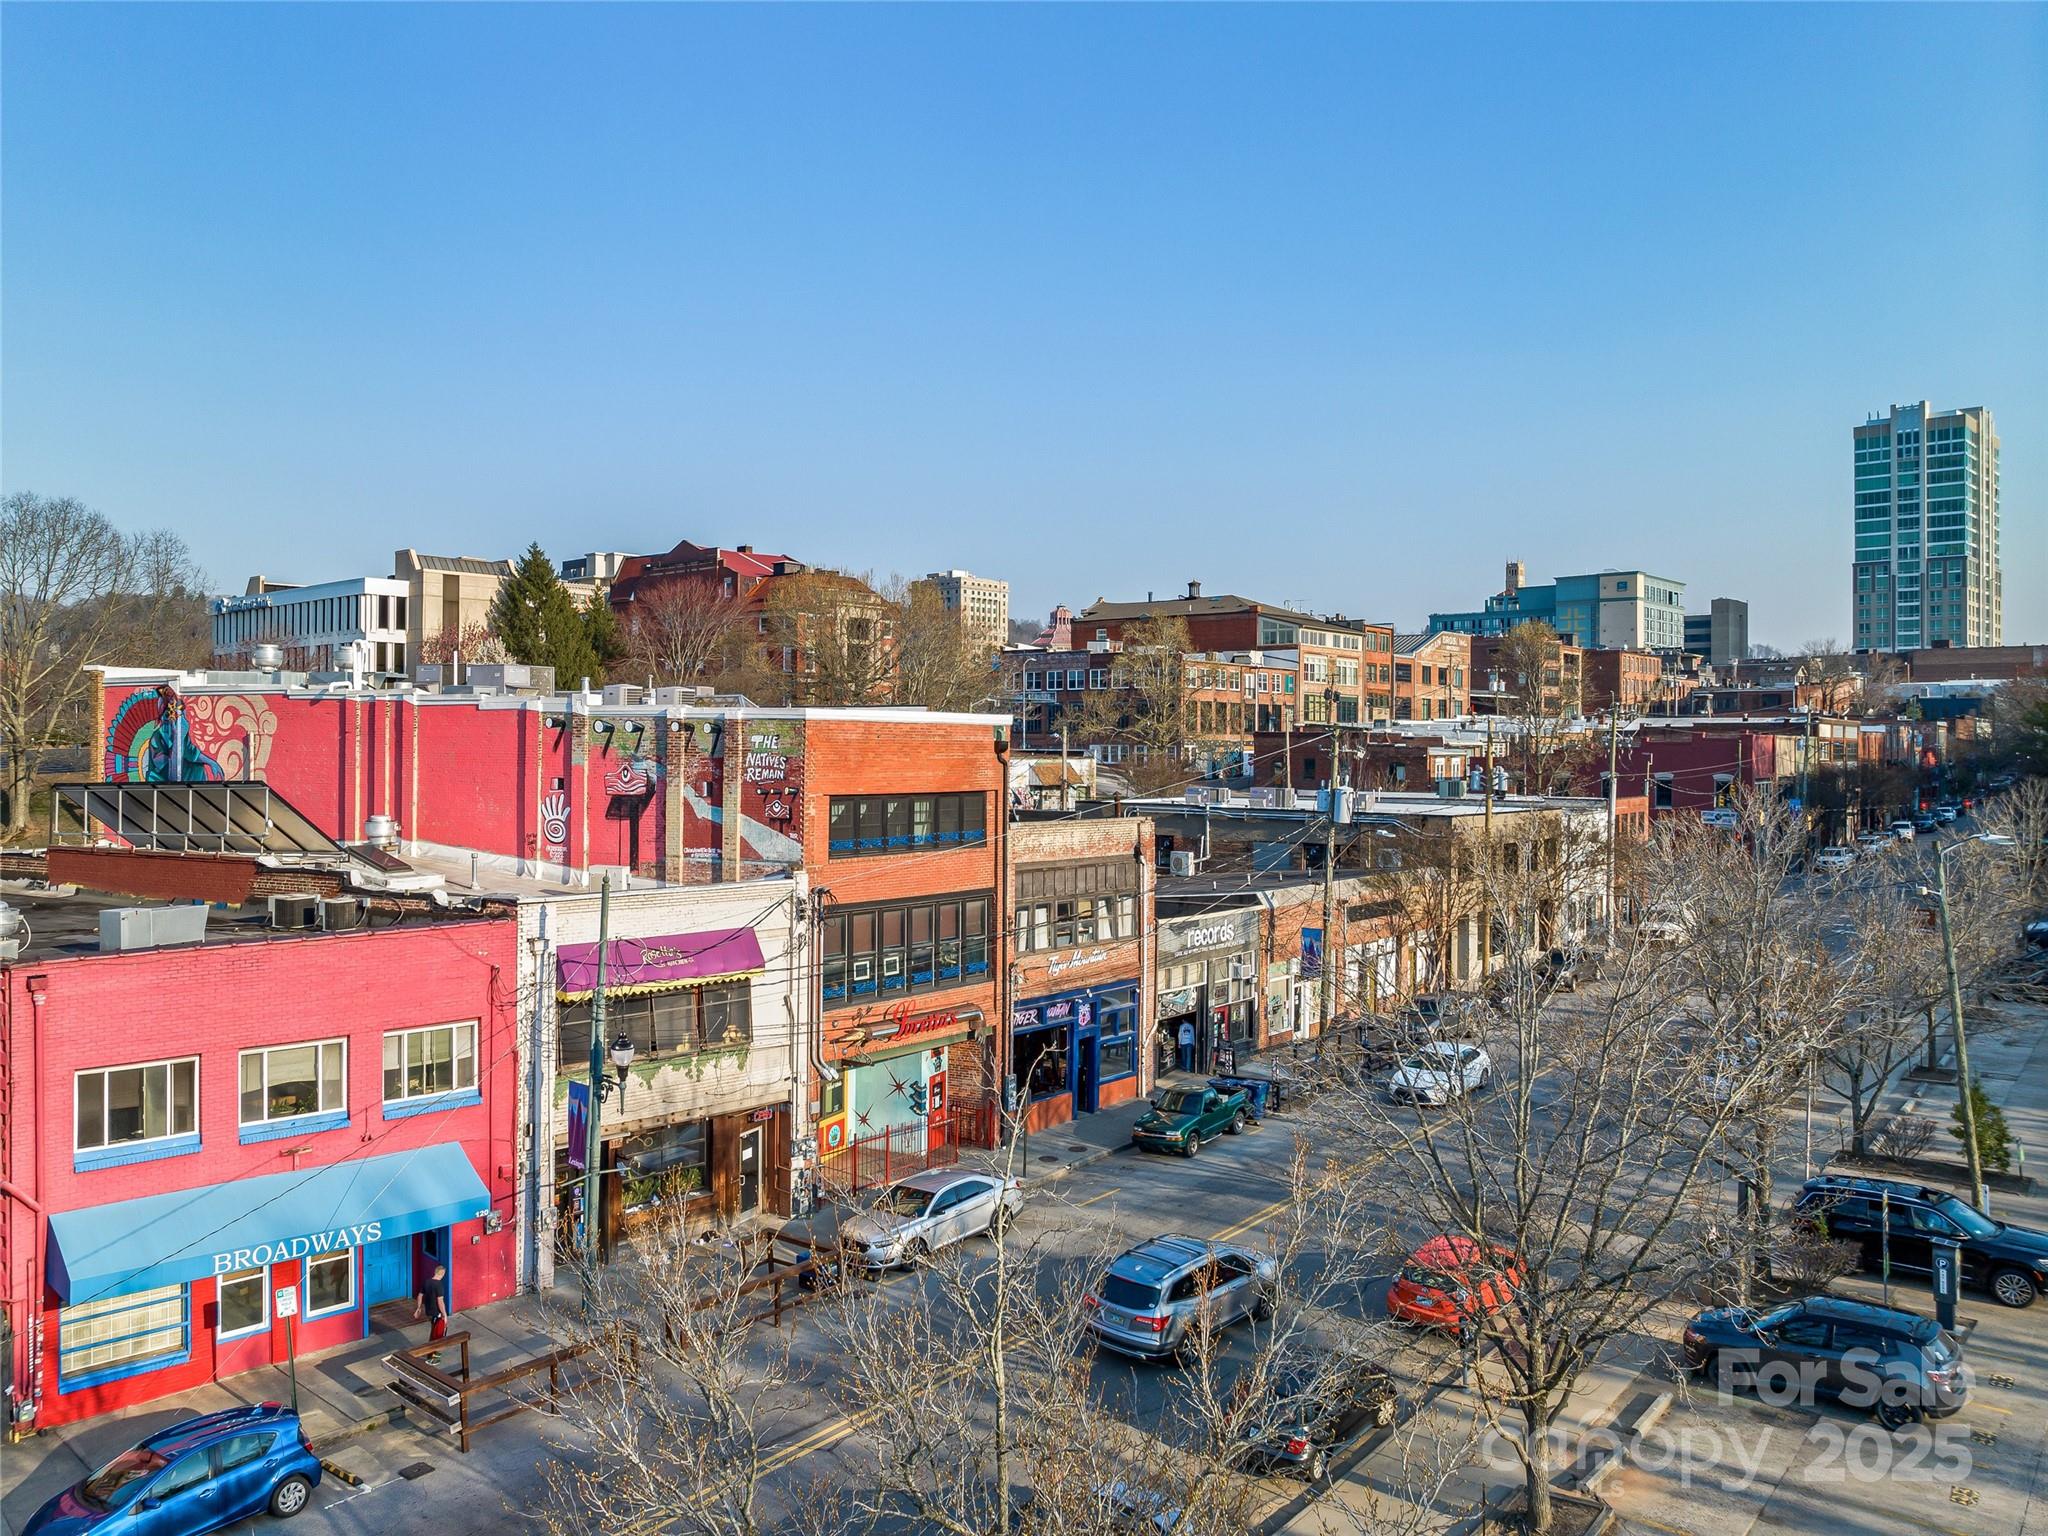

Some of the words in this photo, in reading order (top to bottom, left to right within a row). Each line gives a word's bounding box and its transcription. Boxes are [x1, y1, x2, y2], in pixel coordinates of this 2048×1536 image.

[751, 735, 779, 749] THE
[746, 767, 784, 782] REMAIN
[1187, 919, 1235, 948] records
[475, 1209, 489, 1218] 120
[212, 1221, 382, 1275] BROADWAYS
